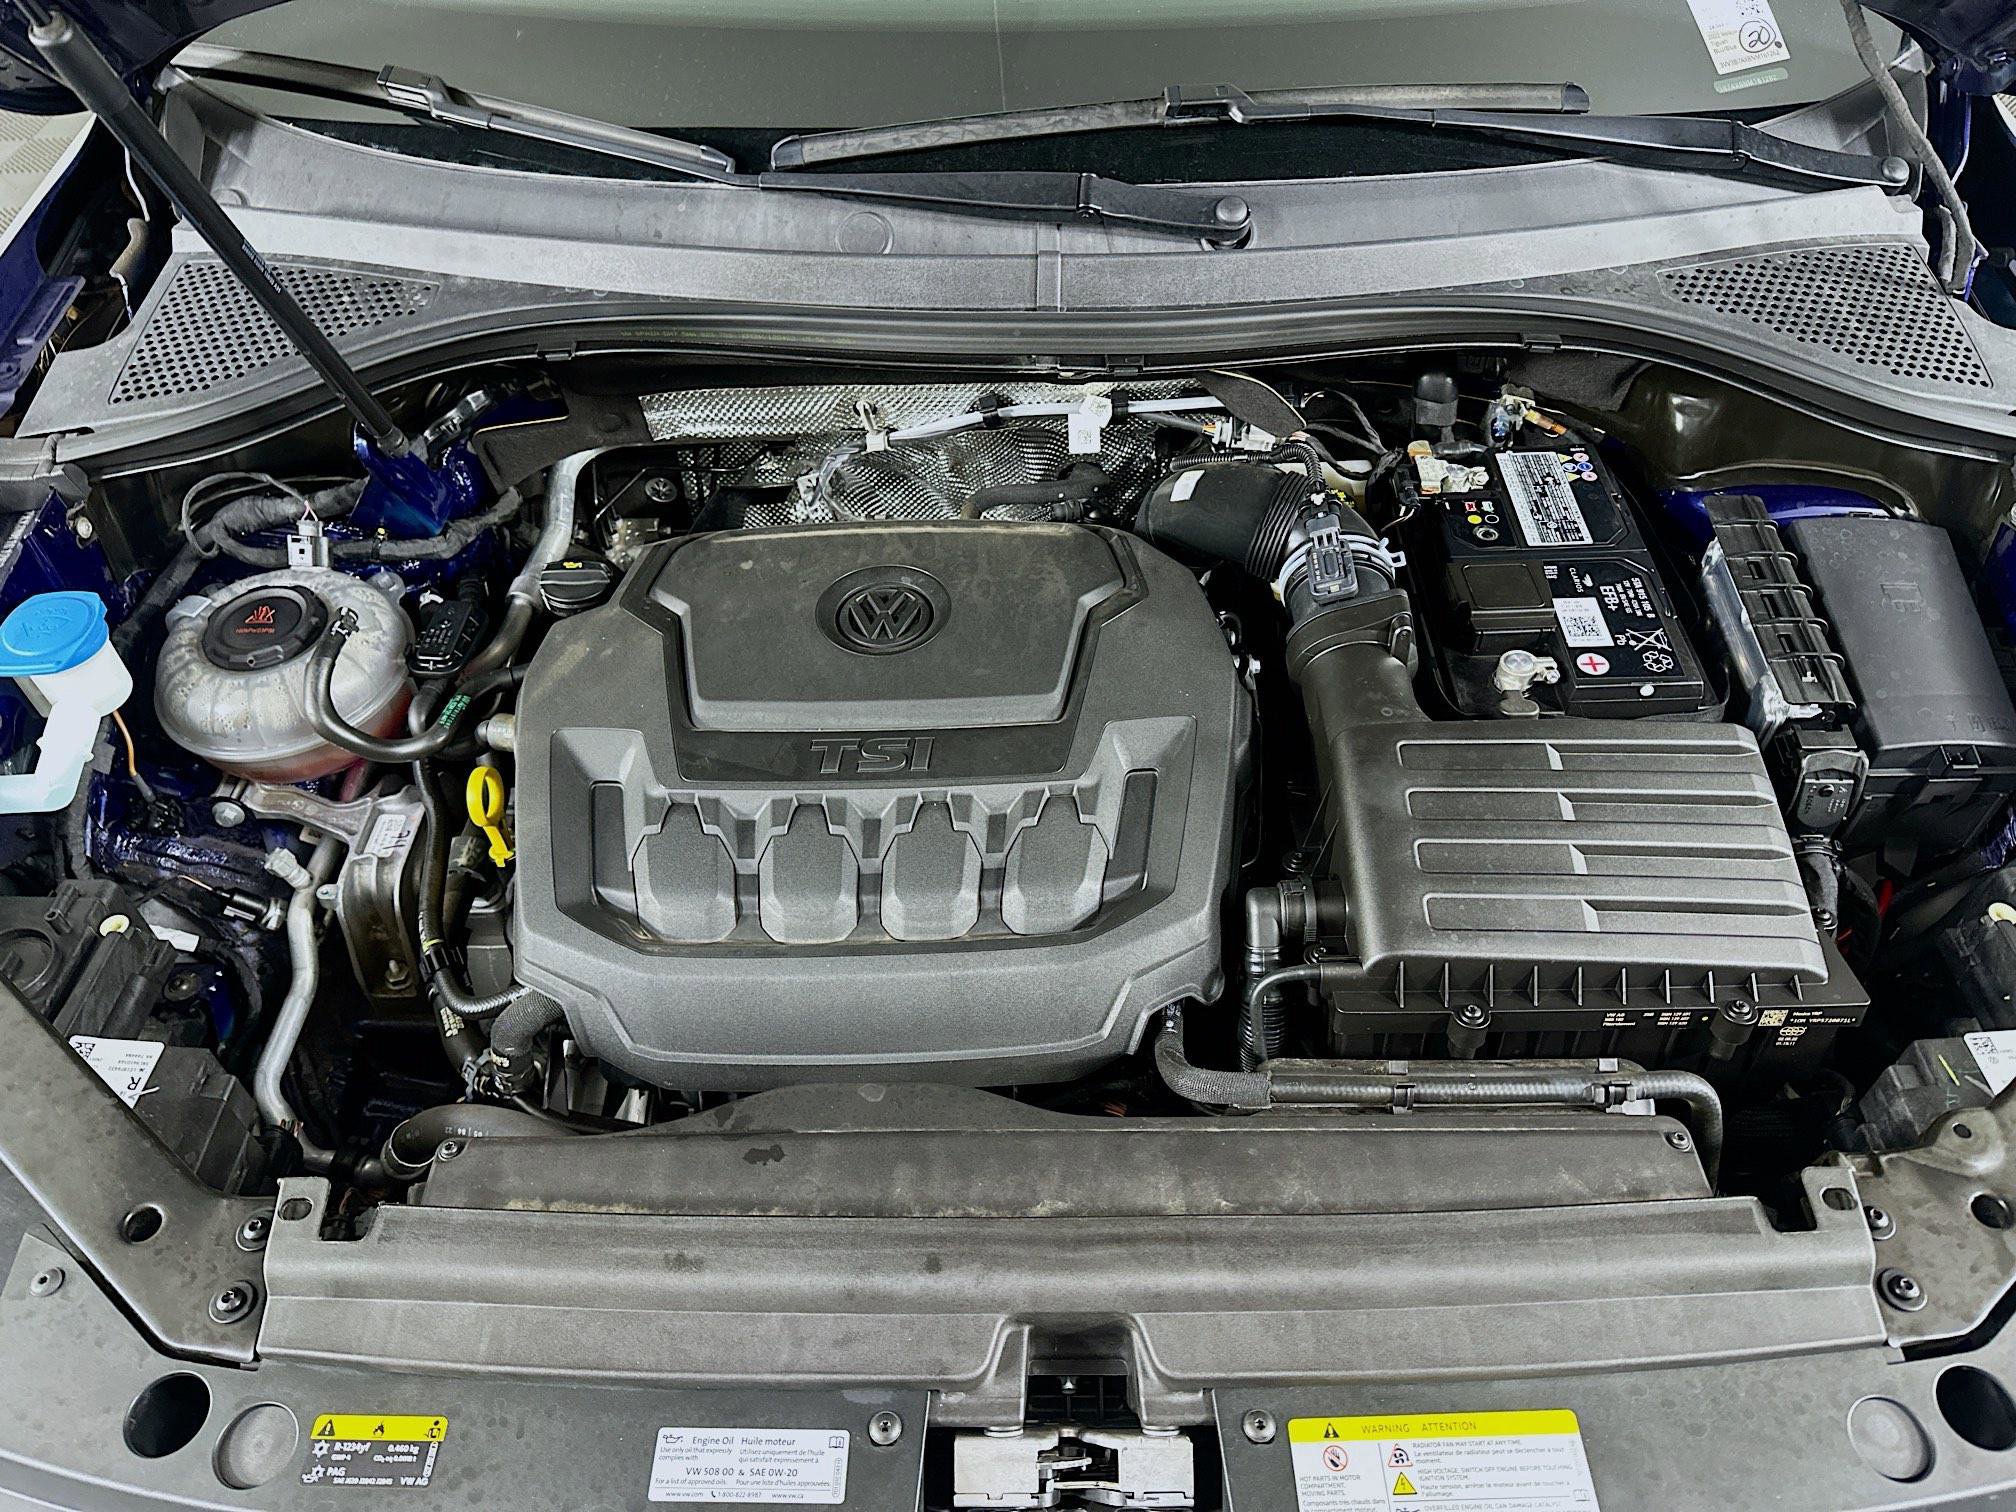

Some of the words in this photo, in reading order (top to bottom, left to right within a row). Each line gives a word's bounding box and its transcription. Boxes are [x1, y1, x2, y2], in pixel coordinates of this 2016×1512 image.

[1748, 25, 1771, 48] 20
[1569, 567, 1584, 593] CLARIOS
[1599, 585, 1620, 611] EFB+
[1614, 634, 1628, 646] Pb
[811, 737, 935, 773] TSI
[127, 1076, 142, 1090] R
[1361, 1423, 1410, 1434] WARNING
[1421, 1421, 1477, 1432] ATTENTION
[692, 1436, 722, 1446] Engine
[722, 1436, 734, 1444] Oil
[741, 1437, 763, 1445] Huile
[764, 1438, 795, 1446] moteur
[739, 1456, 749, 1464] qui
[326, 1467, 347, 1477] PAG
[686, 1467, 702, 1476] VW
[703, 1467, 720, 1476] 508
[722, 1467, 734, 1476] 00
[750, 1468, 767, 1477] SAE
[768, 1468, 798, 1477] 0W-20
[400, 1477, 414, 1485] VW
[414, 1477, 429, 1486] AG
[687, 1478, 715, 1486] approved
